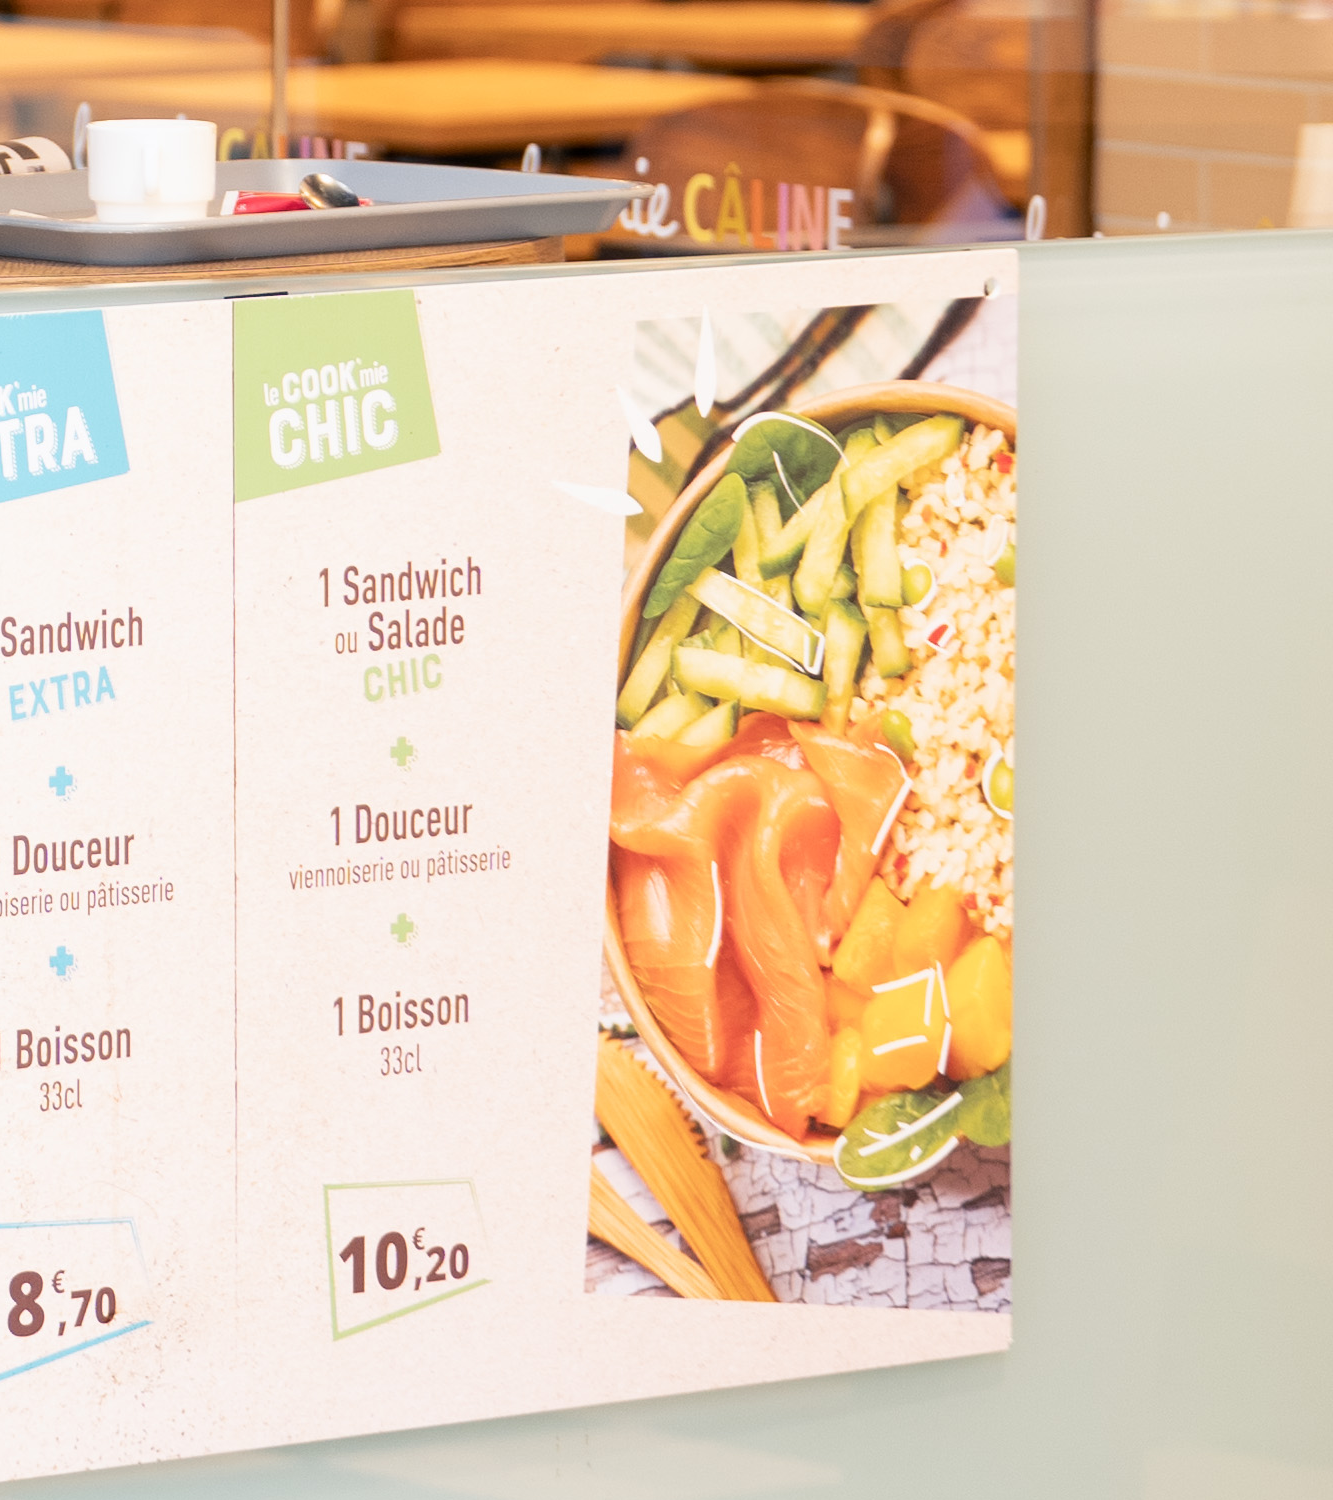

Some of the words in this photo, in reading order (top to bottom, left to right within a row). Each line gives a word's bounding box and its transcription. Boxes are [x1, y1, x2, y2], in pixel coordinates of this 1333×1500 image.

[684, 160, 855, 251] CÂLINE
[263, 381, 280, 407] le
[267, 389, 400, 470] CHIC
[318, 567, 331, 609] 1
[342, 555, 483, 607] Sandwich
[0, 606, 144, 659] Sandwich
[333, 631, 359, 656] ou
[367, 604, 466, 652] Salade
[7, 665, 117, 722] EXTRA
[362, 652, 443, 703] CHIC
[329, 805, 342, 848] 1
[354, 803, 475, 845] Douceur
[11, 833, 136, 877] Douceur
[287, 861, 396, 892] viennoiserie
[399, 859, 421, 881] ou
[426, 850, 512, 885] pâtisserie
[58, 891, 81, 913] ou
[86, 881, 175, 917] pâtisserie
[332, 996, 345, 1038] 1
[357, 990, 470, 1036] Boisson
[15, 1025, 132, 1071] Boisson
[379, 1043, 424, 1078] 33cl
[38, 1078, 84, 1114] 33cl
